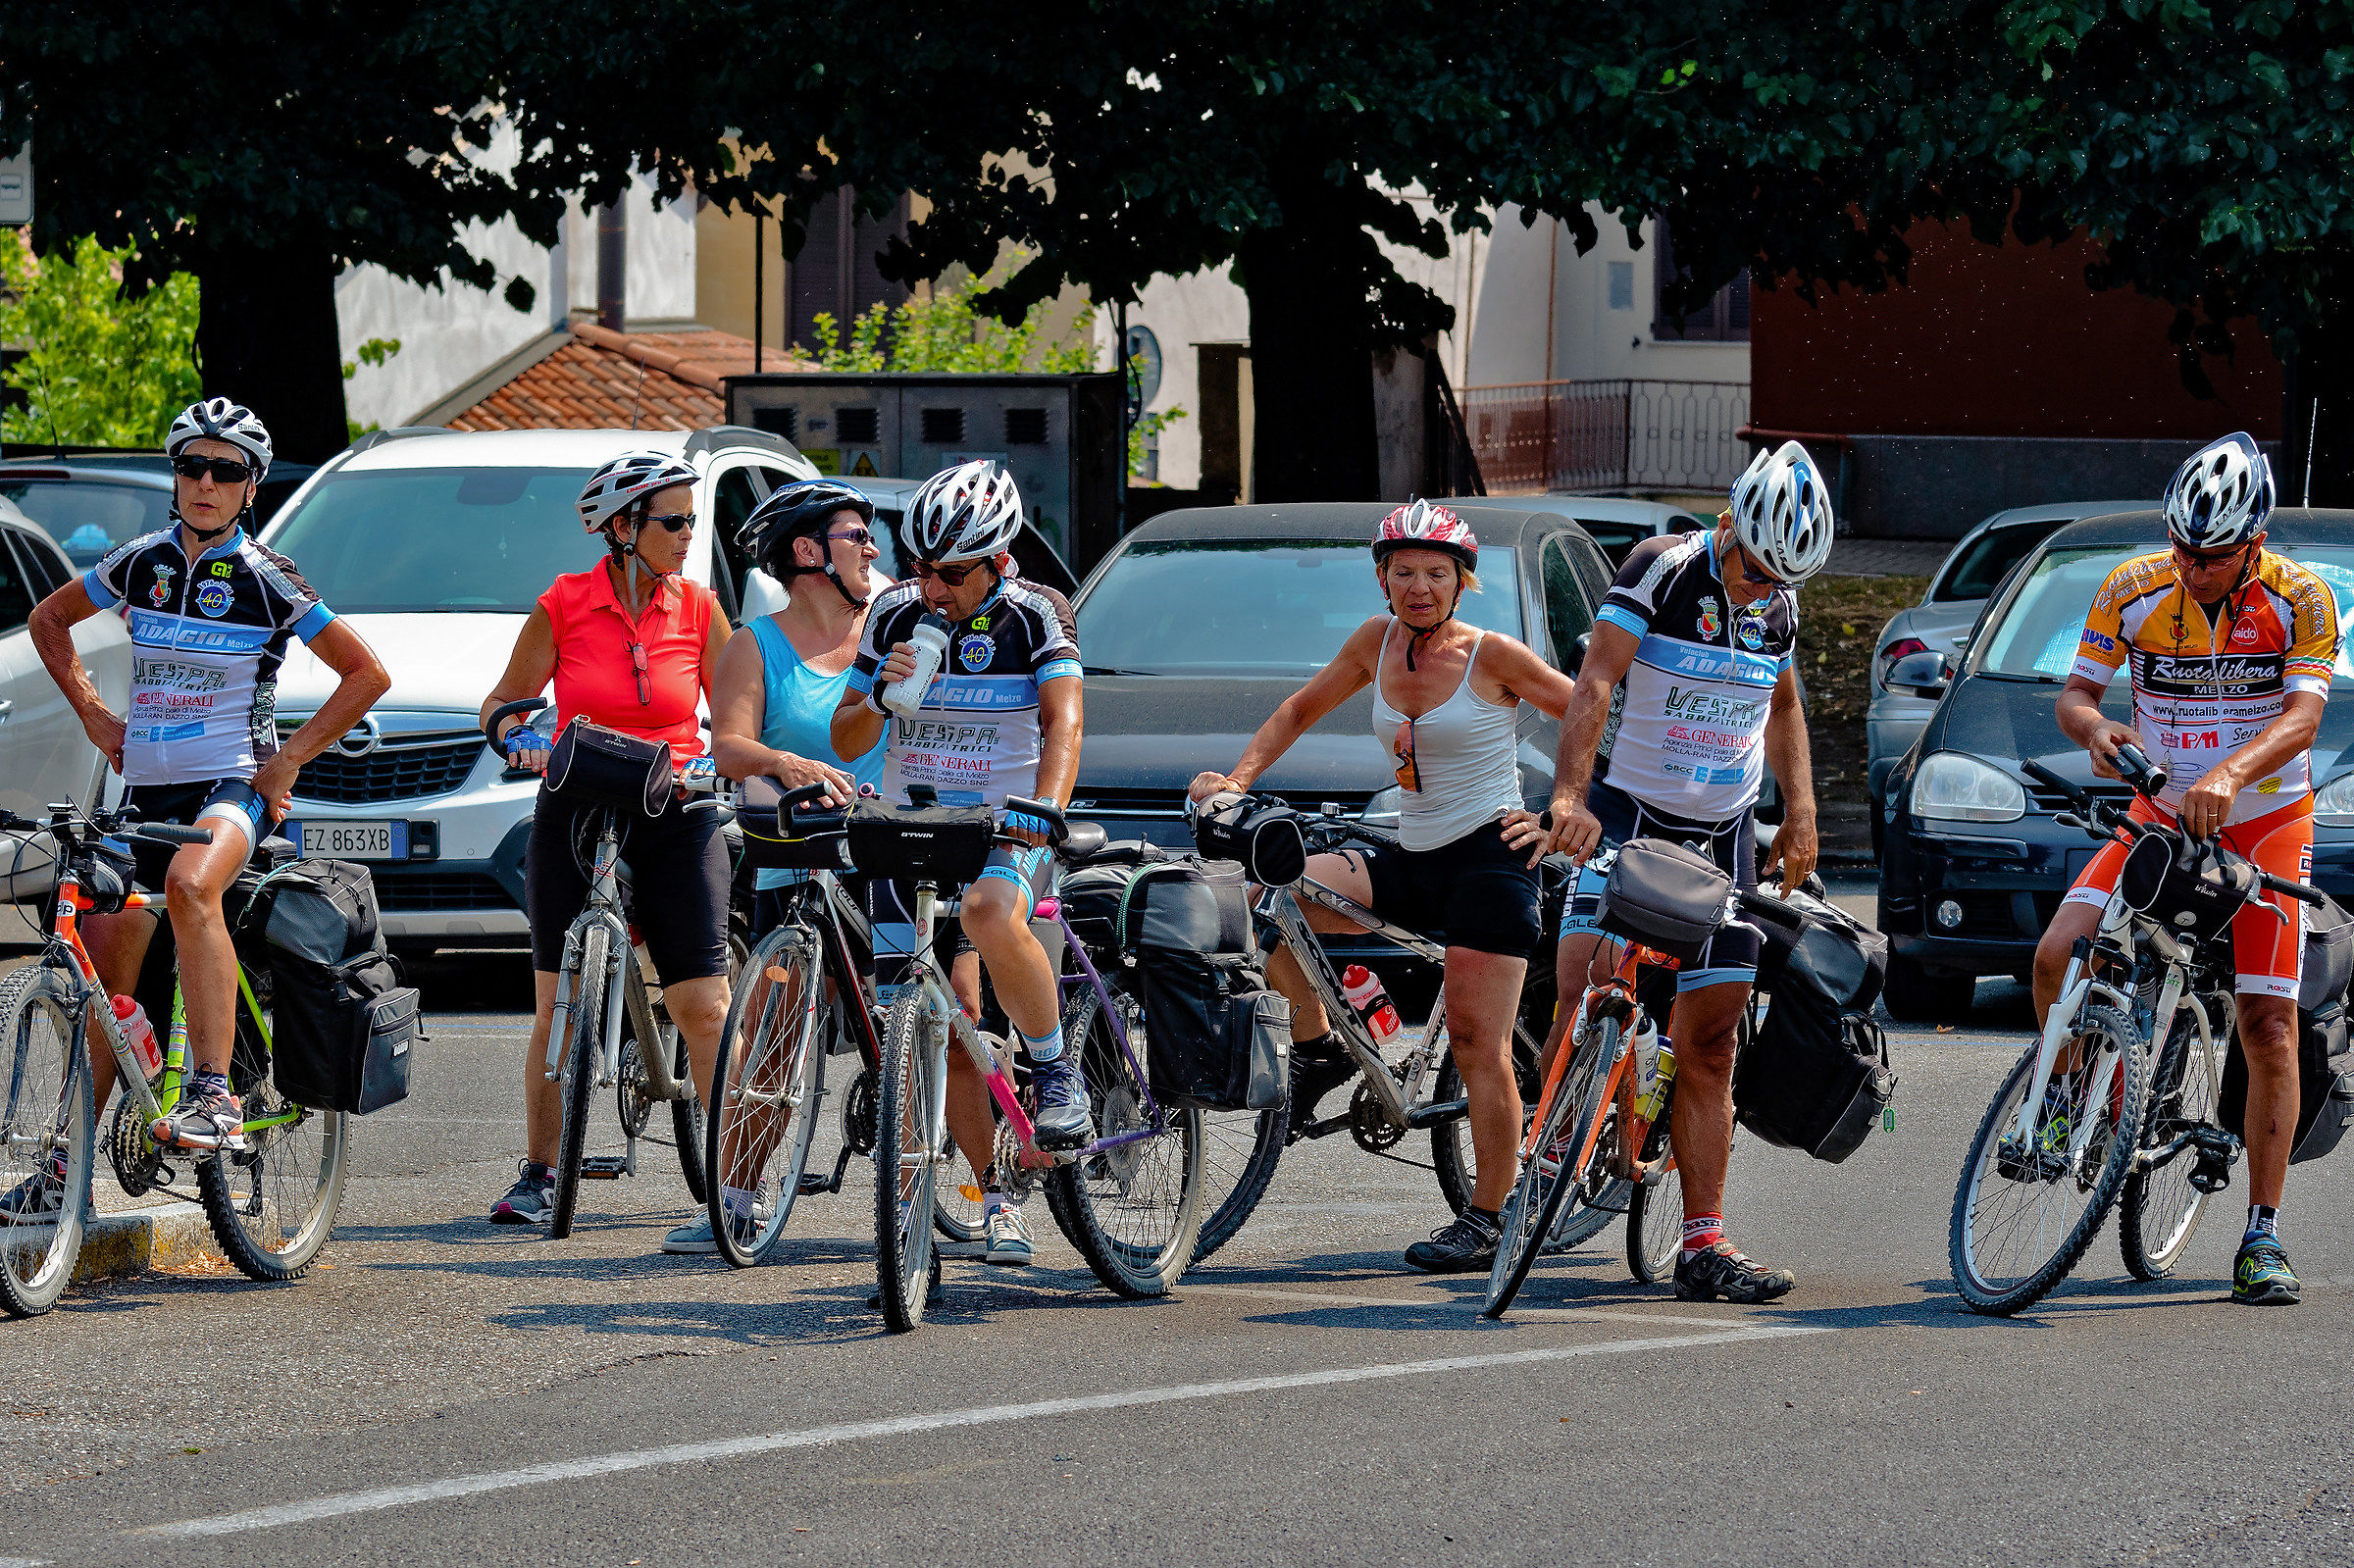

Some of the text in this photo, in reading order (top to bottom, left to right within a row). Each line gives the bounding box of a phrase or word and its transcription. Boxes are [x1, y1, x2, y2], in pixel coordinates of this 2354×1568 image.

[956, 528, 986, 553] Santini
[202, 592, 223, 608] 40
[135, 623, 254, 649] ADAGIO Melzo
[1743, 628, 1758, 641] 40
[2081, 628, 2116, 652] AVIS
[2233, 628, 2257, 639] aido
[965, 646, 985, 663] 40
[1679, 646, 1710, 658] Veloclub
[133, 656, 226, 686] VESPA
[1675, 655, 1766, 681] ADAGIO
[2152, 656, 2278, 682] Ruotalibera
[925, 686, 1022, 704] AGIO Melzo
[1664, 685, 1759, 721] VESPA
[1663, 709, 1754, 729] SABBIATRICI
[897, 716, 998, 745] VESPA
[898, 739, 993, 753] SABBIATRICI
[919, 753, 992, 772] GENERALI
[1673, 765, 1694, 775] BCC
[304, 829, 389, 851] EZ 863XB
[1325, 893, 1353, 911] XC
